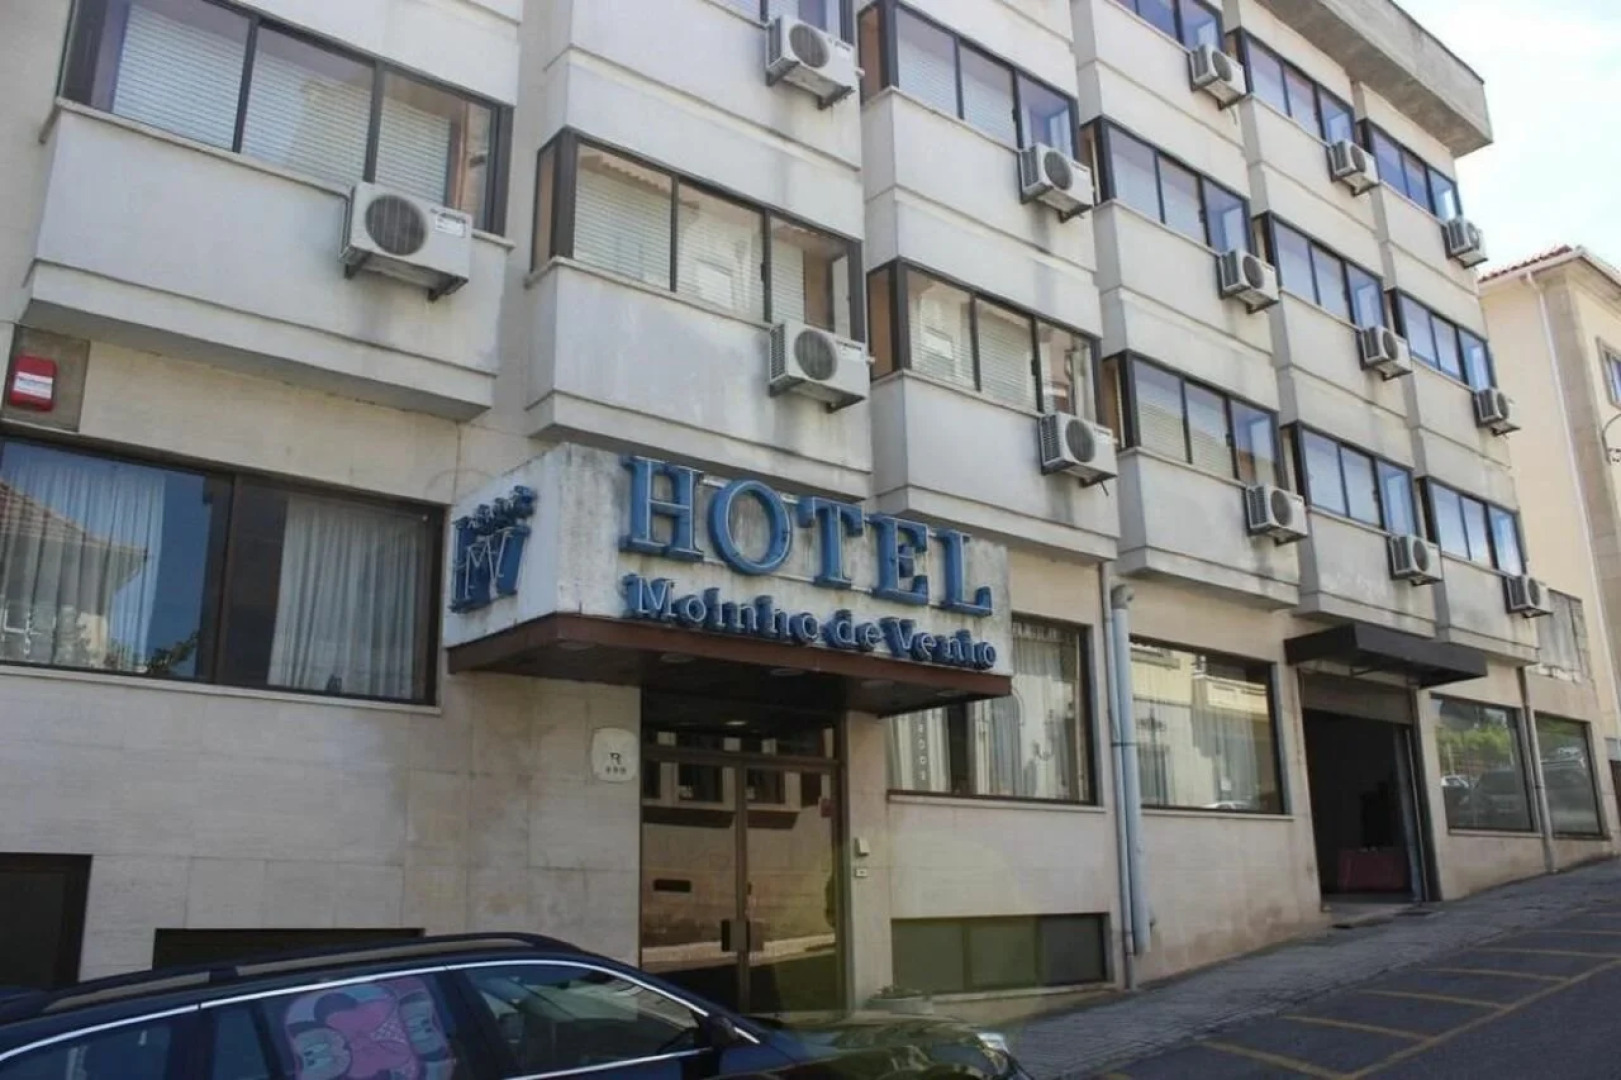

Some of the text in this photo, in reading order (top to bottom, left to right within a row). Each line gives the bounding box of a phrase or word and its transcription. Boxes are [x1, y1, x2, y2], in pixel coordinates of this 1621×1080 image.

[619, 456, 992, 616] HOTEL
[820, 609, 881, 652] de
[879, 616, 997, 670] Vento
